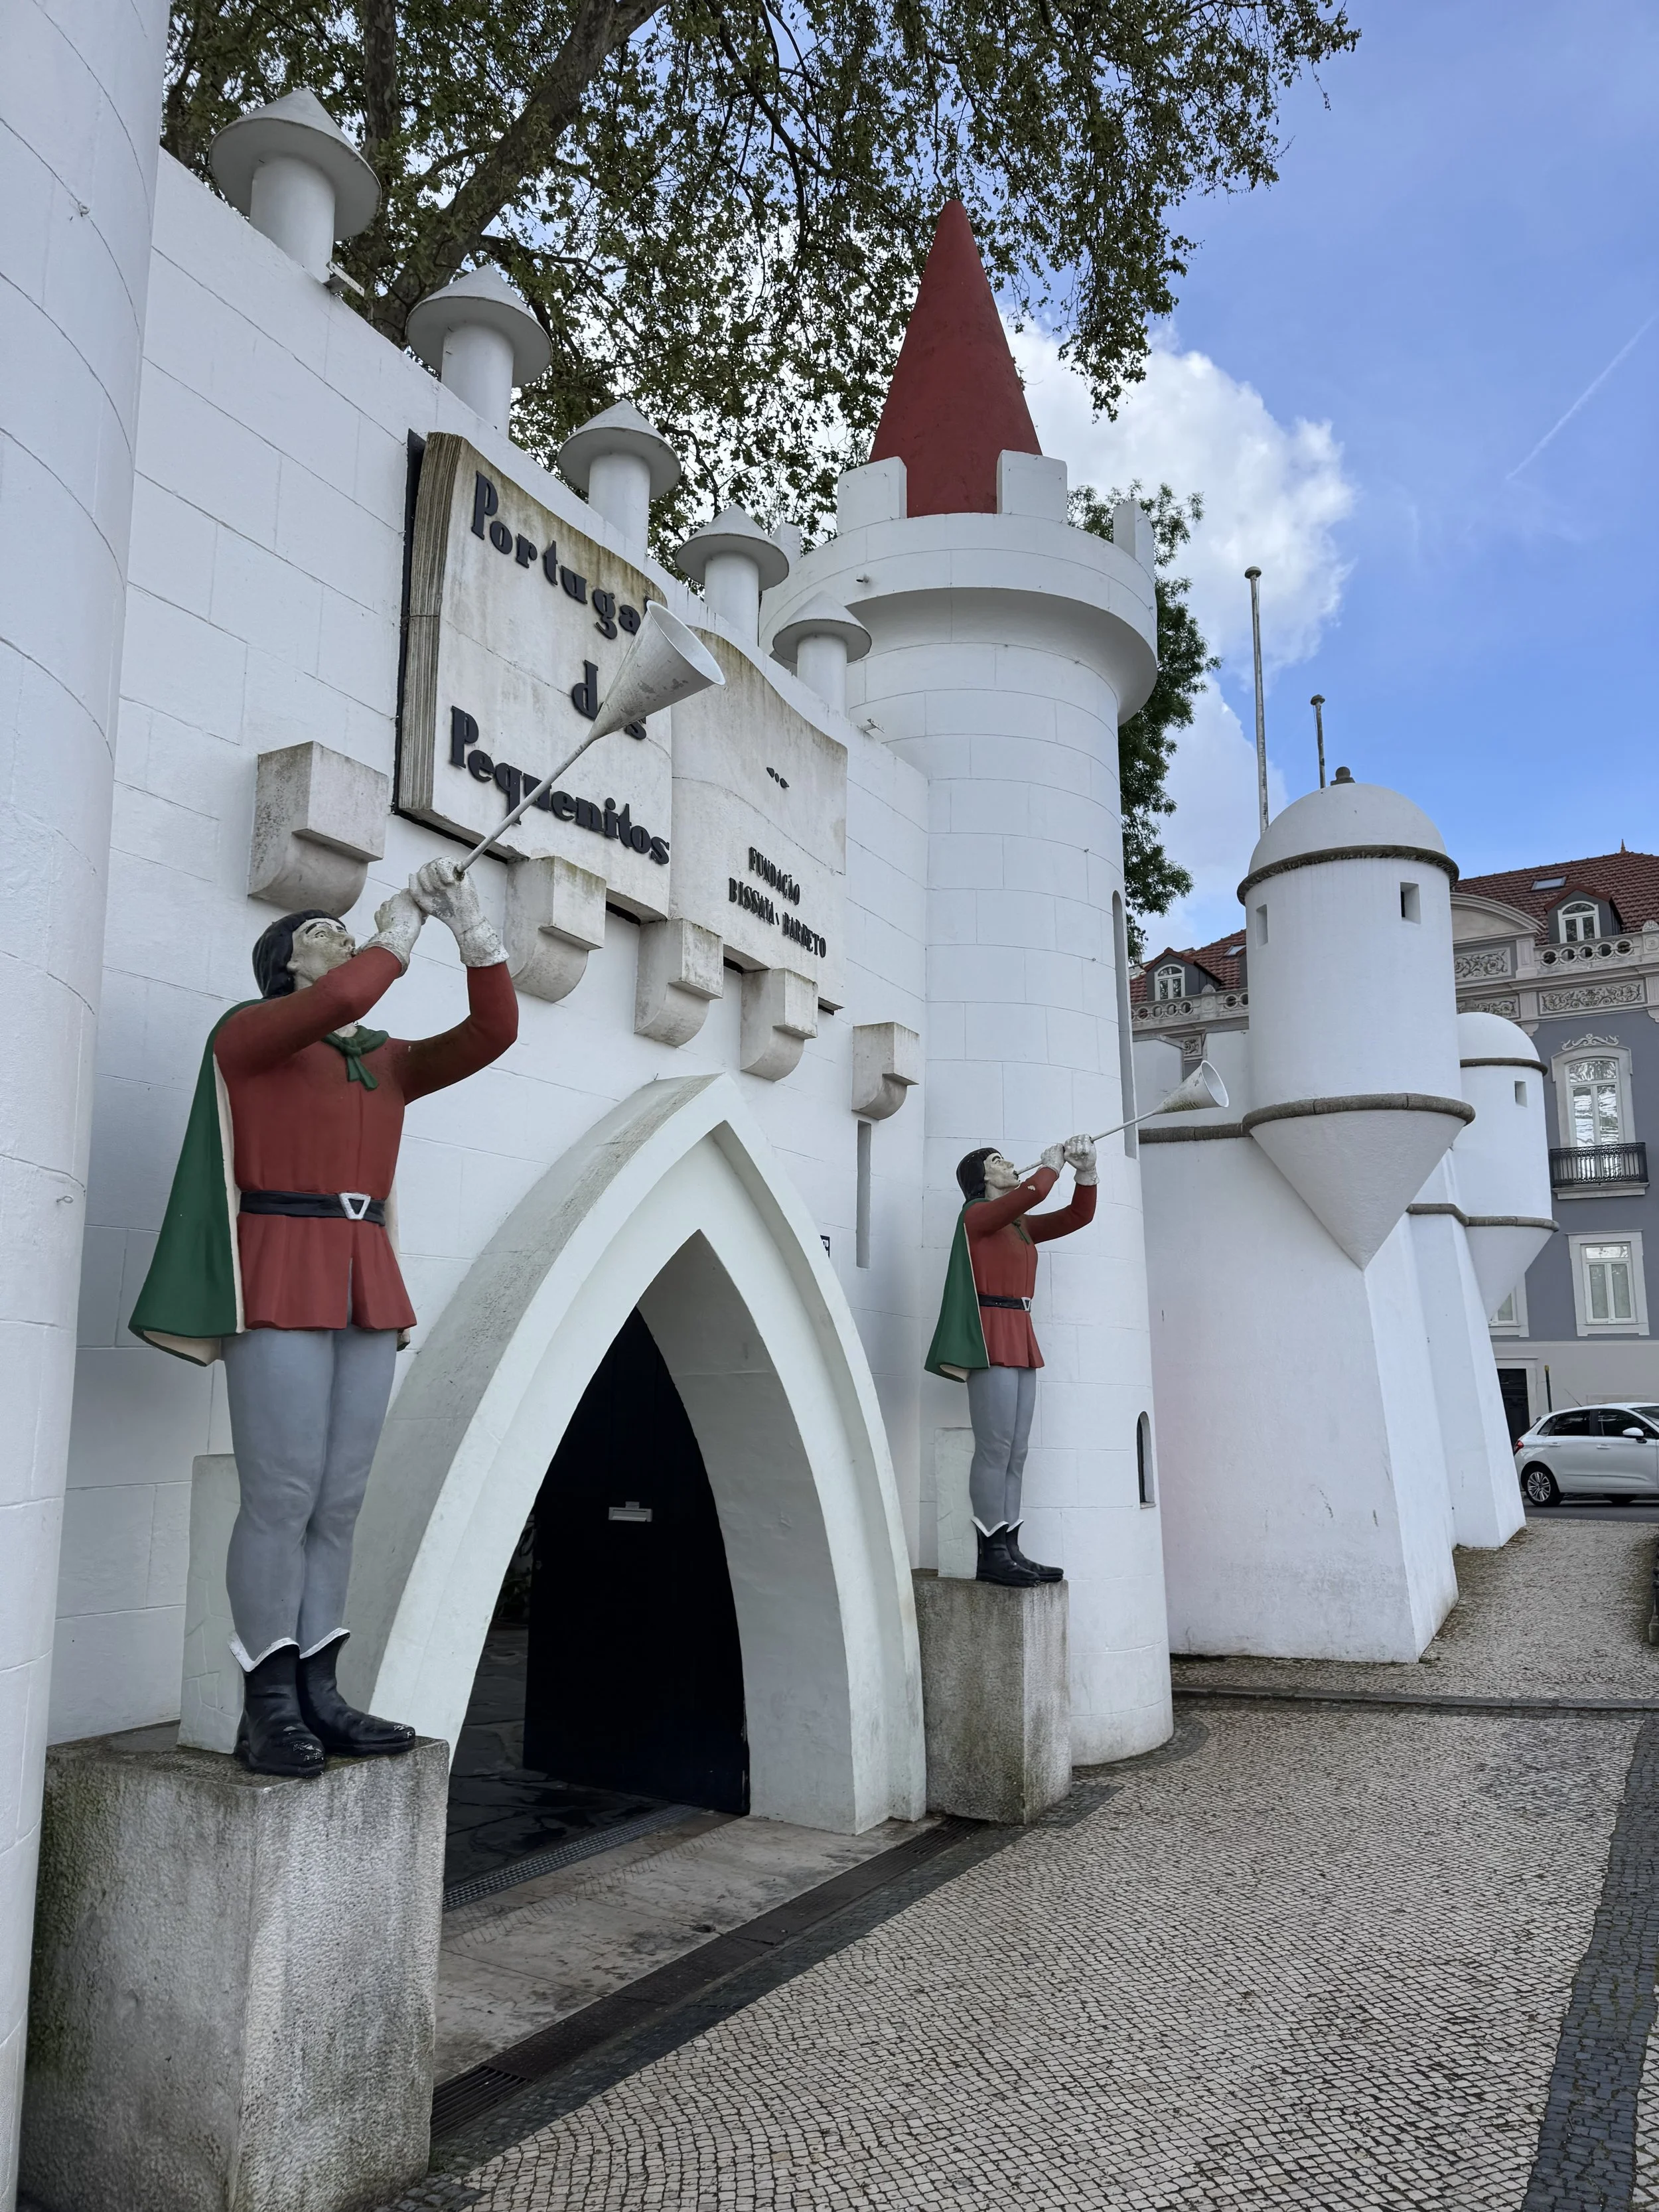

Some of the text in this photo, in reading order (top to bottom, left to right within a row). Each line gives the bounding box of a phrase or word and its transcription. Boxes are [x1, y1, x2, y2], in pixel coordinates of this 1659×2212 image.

[472, 470, 653, 640] Portuga
[571, 659, 647, 740] ds
[450, 705, 670, 865] Pequenitos
[749, 846, 800, 906] FUNDAÇÃO
